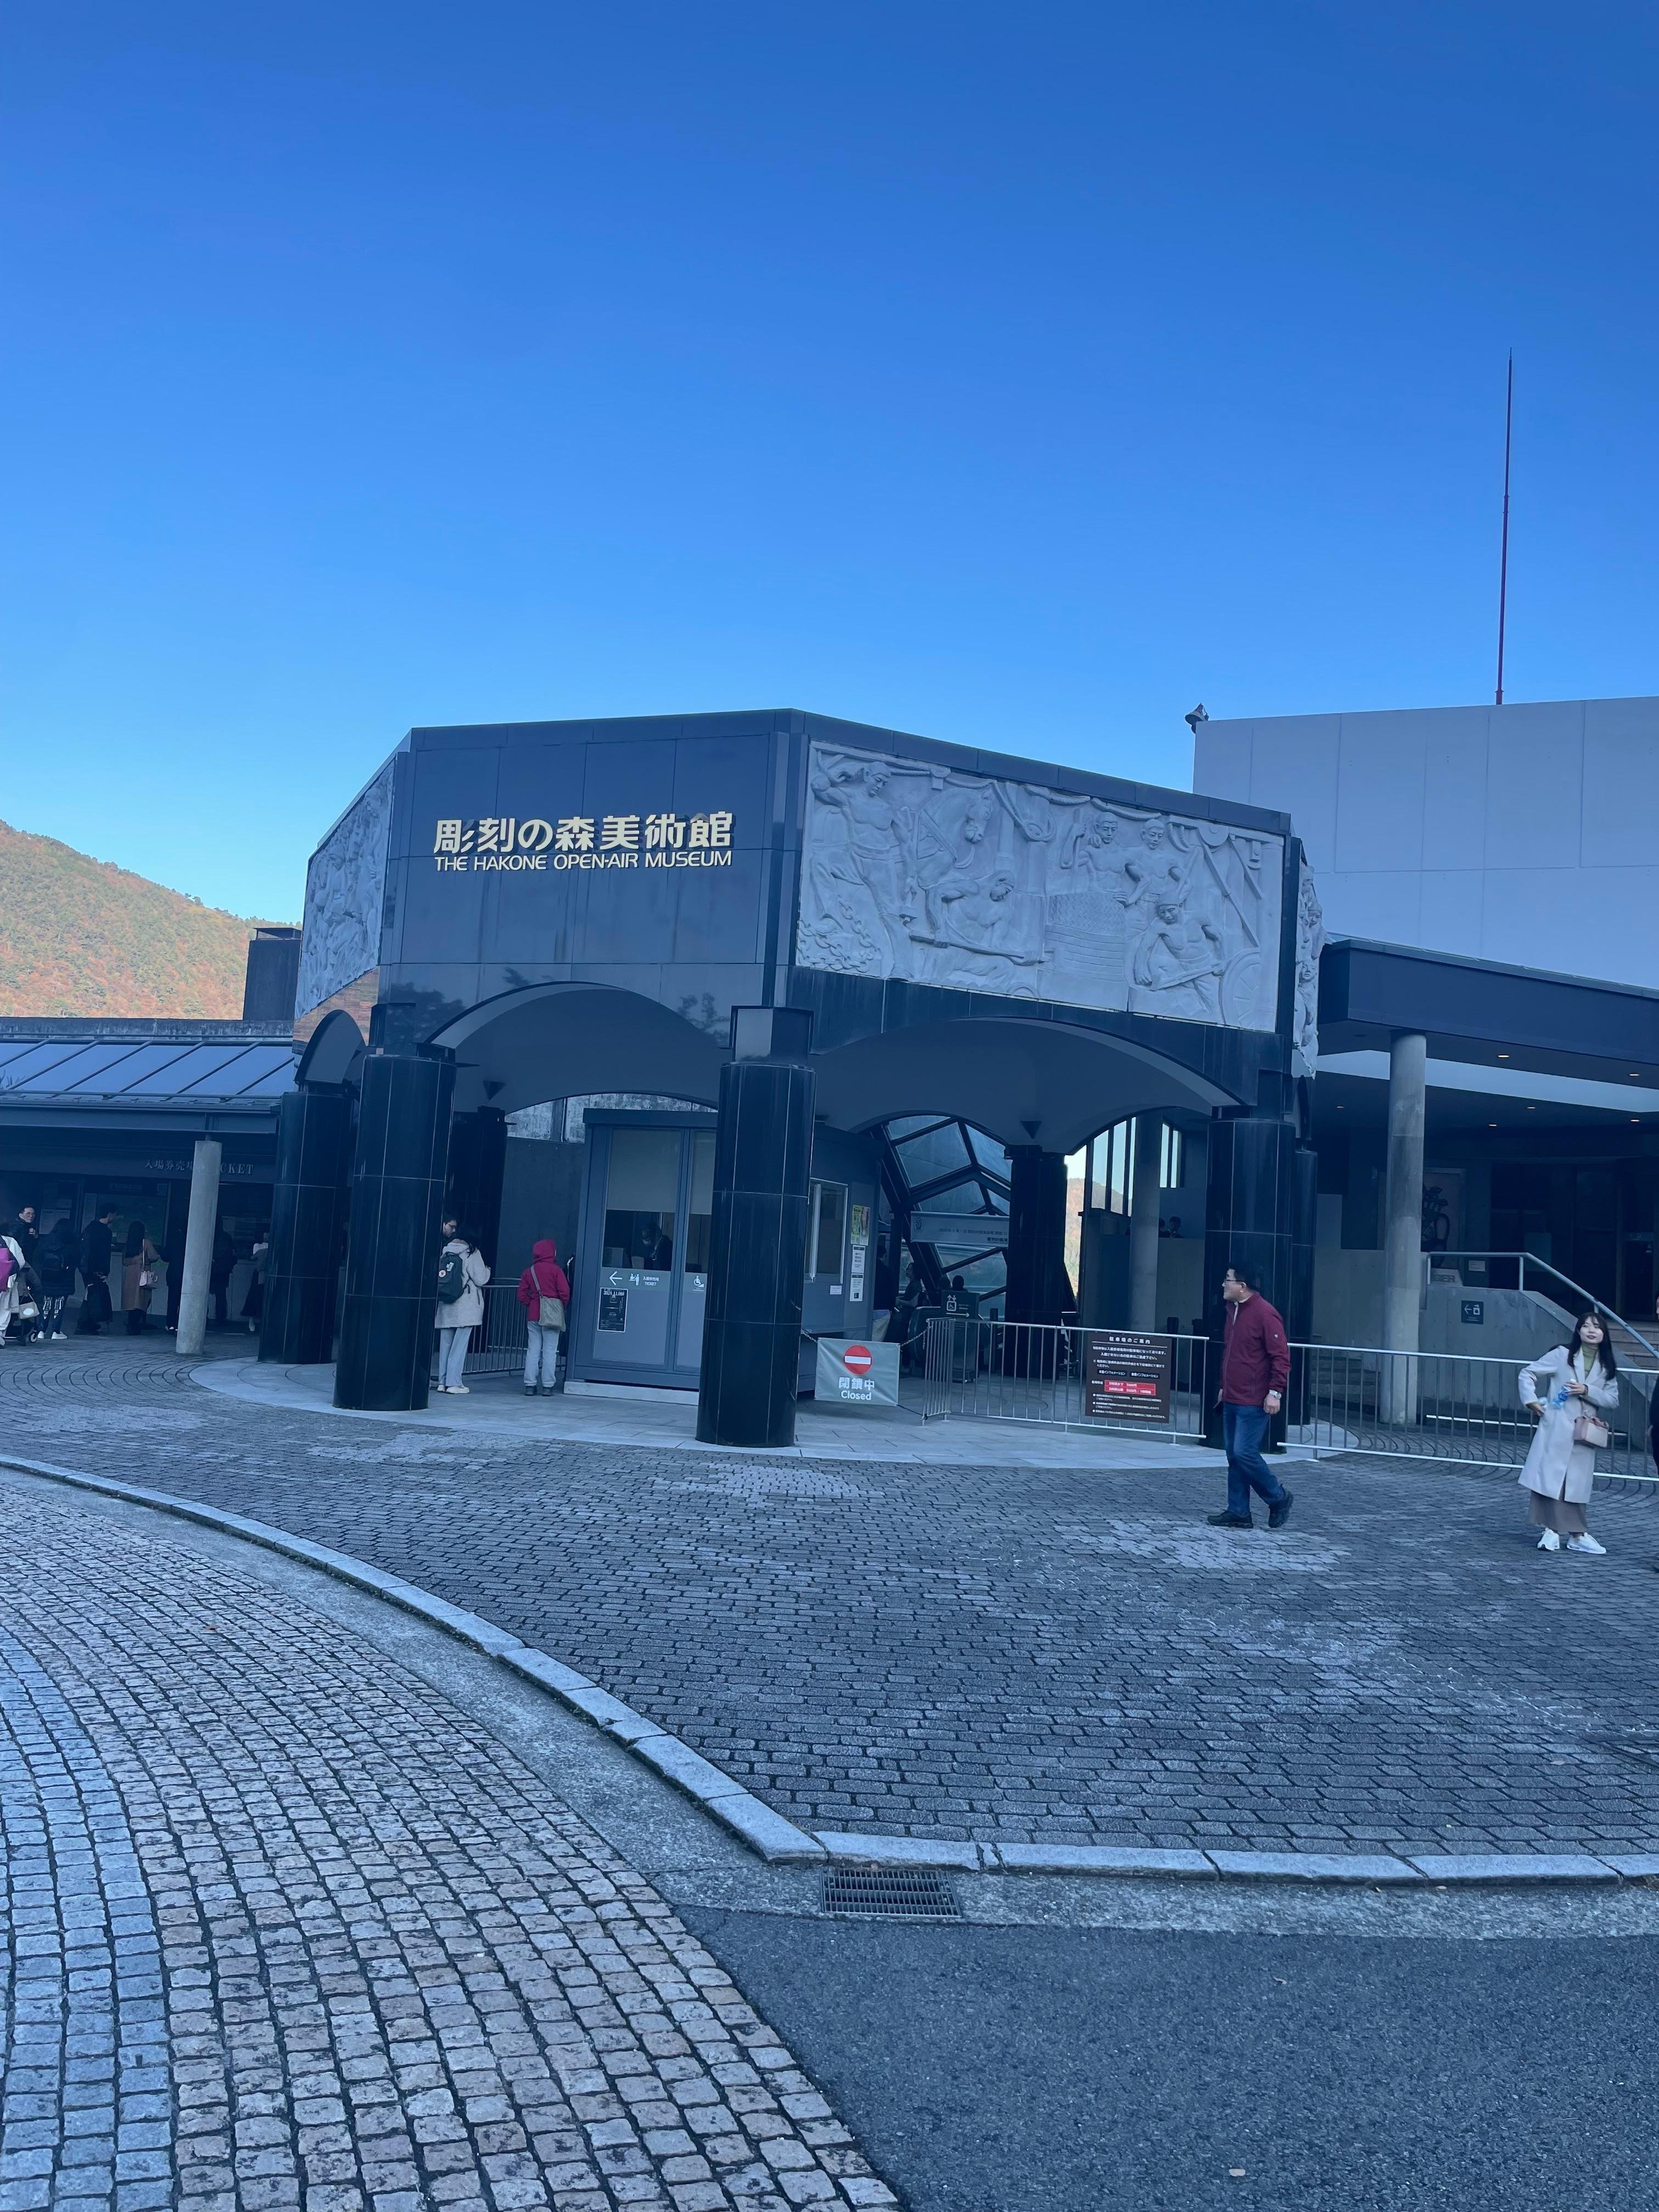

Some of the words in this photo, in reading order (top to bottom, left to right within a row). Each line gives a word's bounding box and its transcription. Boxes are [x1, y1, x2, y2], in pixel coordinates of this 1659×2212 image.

[433, 811, 733, 854] 彫刻の森美術館
[435, 856, 468, 871] THE
[474, 855, 546, 871] HAKONE
[554, 853, 638, 870] OPEN-AIR
[645, 850, 732, 867] MUSEUM
[220, 1163, 254, 1174] CKET
[838, 1376, 875, 1391] 閉鎖中
[840, 1390, 872, 1401] Closed
